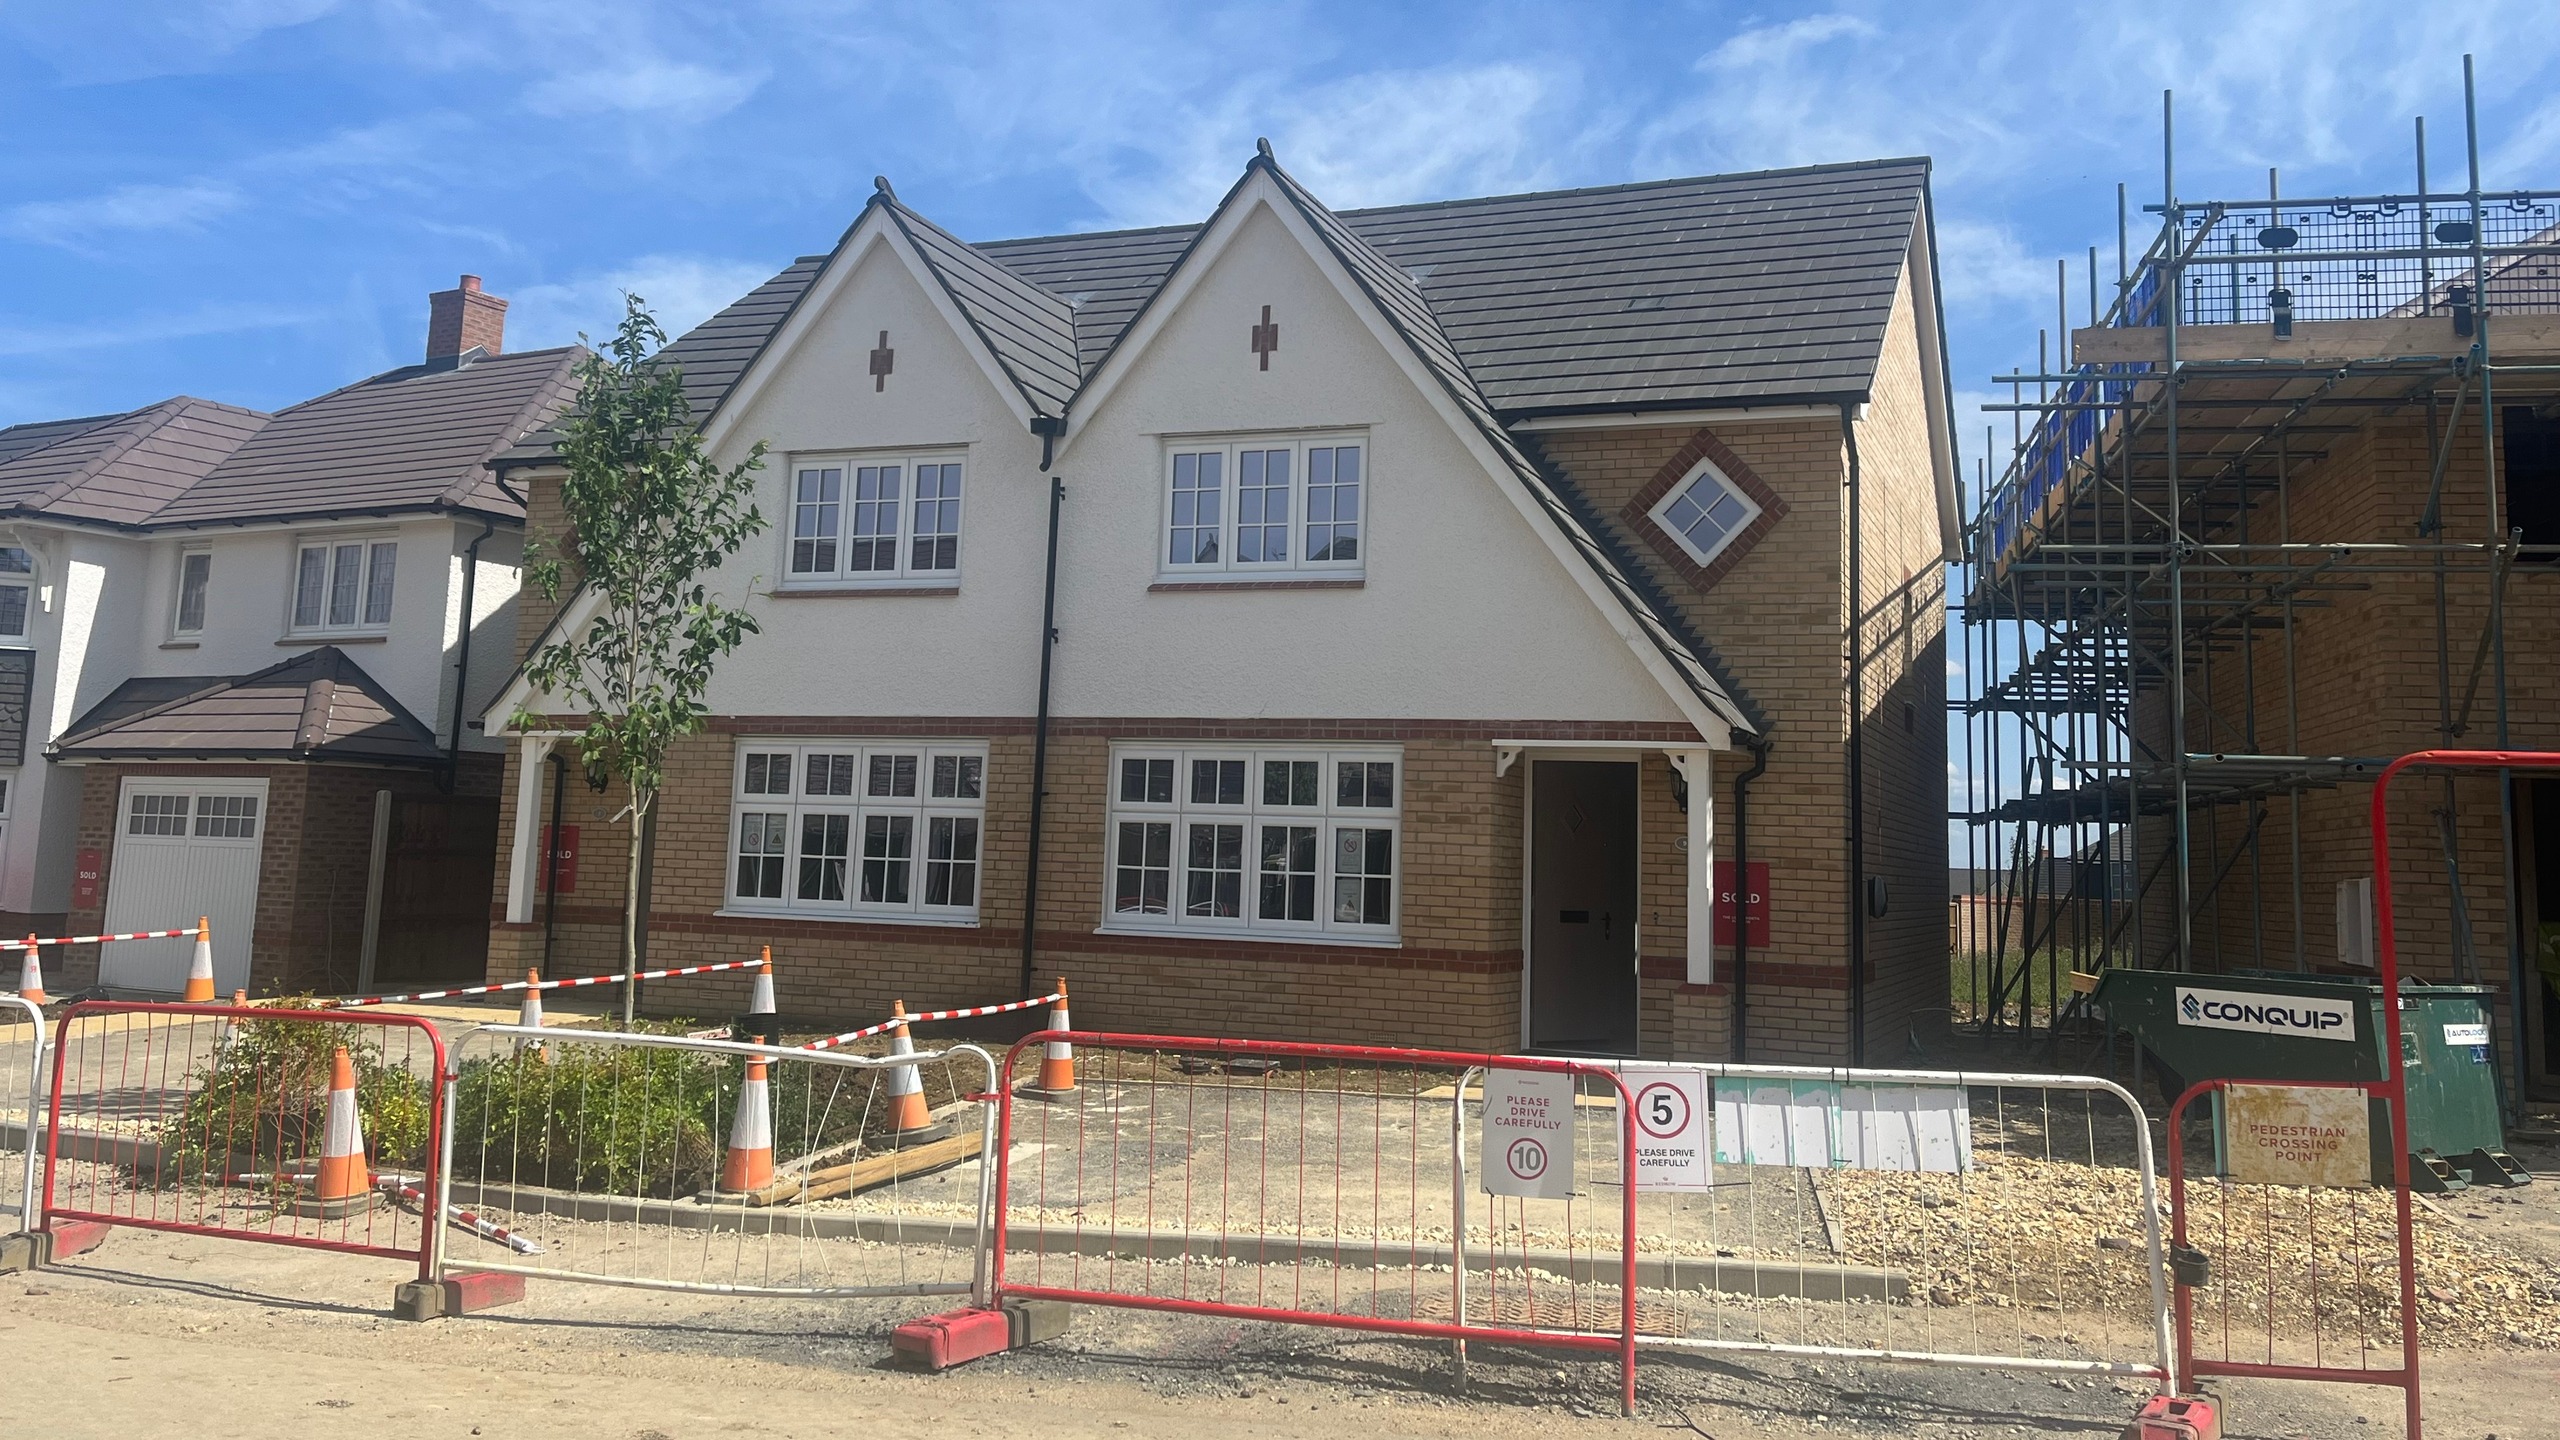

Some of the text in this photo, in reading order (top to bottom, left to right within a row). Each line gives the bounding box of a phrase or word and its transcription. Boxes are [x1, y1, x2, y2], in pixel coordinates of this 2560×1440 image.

[547, 850, 572, 859] SLD
[80, 871, 97, 879] SOLD
[2203, 1001, 2343, 1030] CONQUIP
[1507, 1095, 1550, 1107] PLEASE
[1510, 1107, 1546, 1118] DRIVE
[1652, 1095, 1673, 1126] 5
[1495, 1116, 1561, 1130] CAREFULLY
[2250, 1124, 2346, 1138] PEDESTRIAN
[2259, 1137, 2338, 1150] CROSSING
[1514, 1146, 1541, 1171] 10
[1669, 1149, 1695, 1157] DRIVE
[2275, 1151, 2322, 1162] POINT
[1639, 1158, 1690, 1167] CAREFULLY
